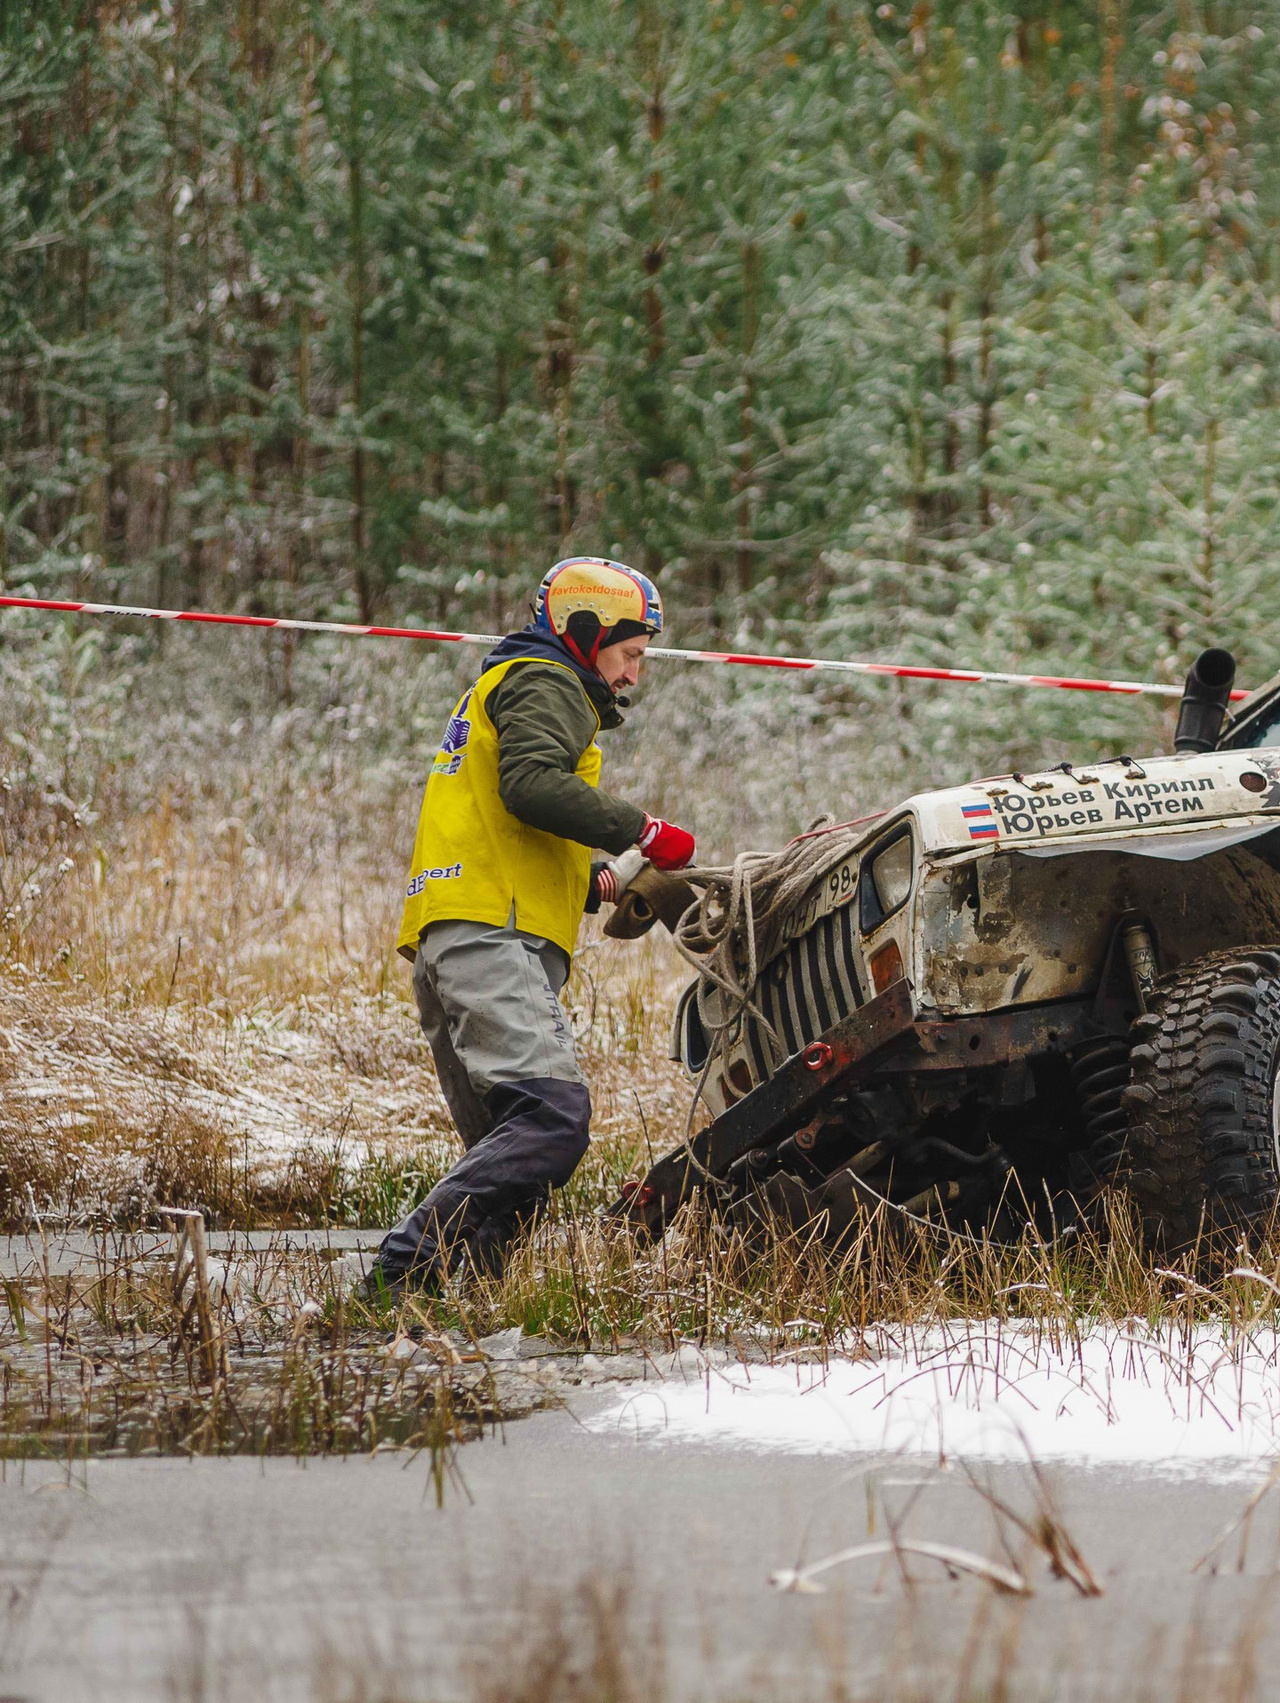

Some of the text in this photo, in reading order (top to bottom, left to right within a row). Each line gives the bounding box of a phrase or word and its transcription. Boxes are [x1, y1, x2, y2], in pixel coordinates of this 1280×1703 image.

[551, 584, 635, 599] #avtokotdosaaf
[992, 778, 1215, 815] Юрьев Кирилл
[1001, 795, 1204, 836] Юрьев Артем
[830, 865, 851, 901] 98
